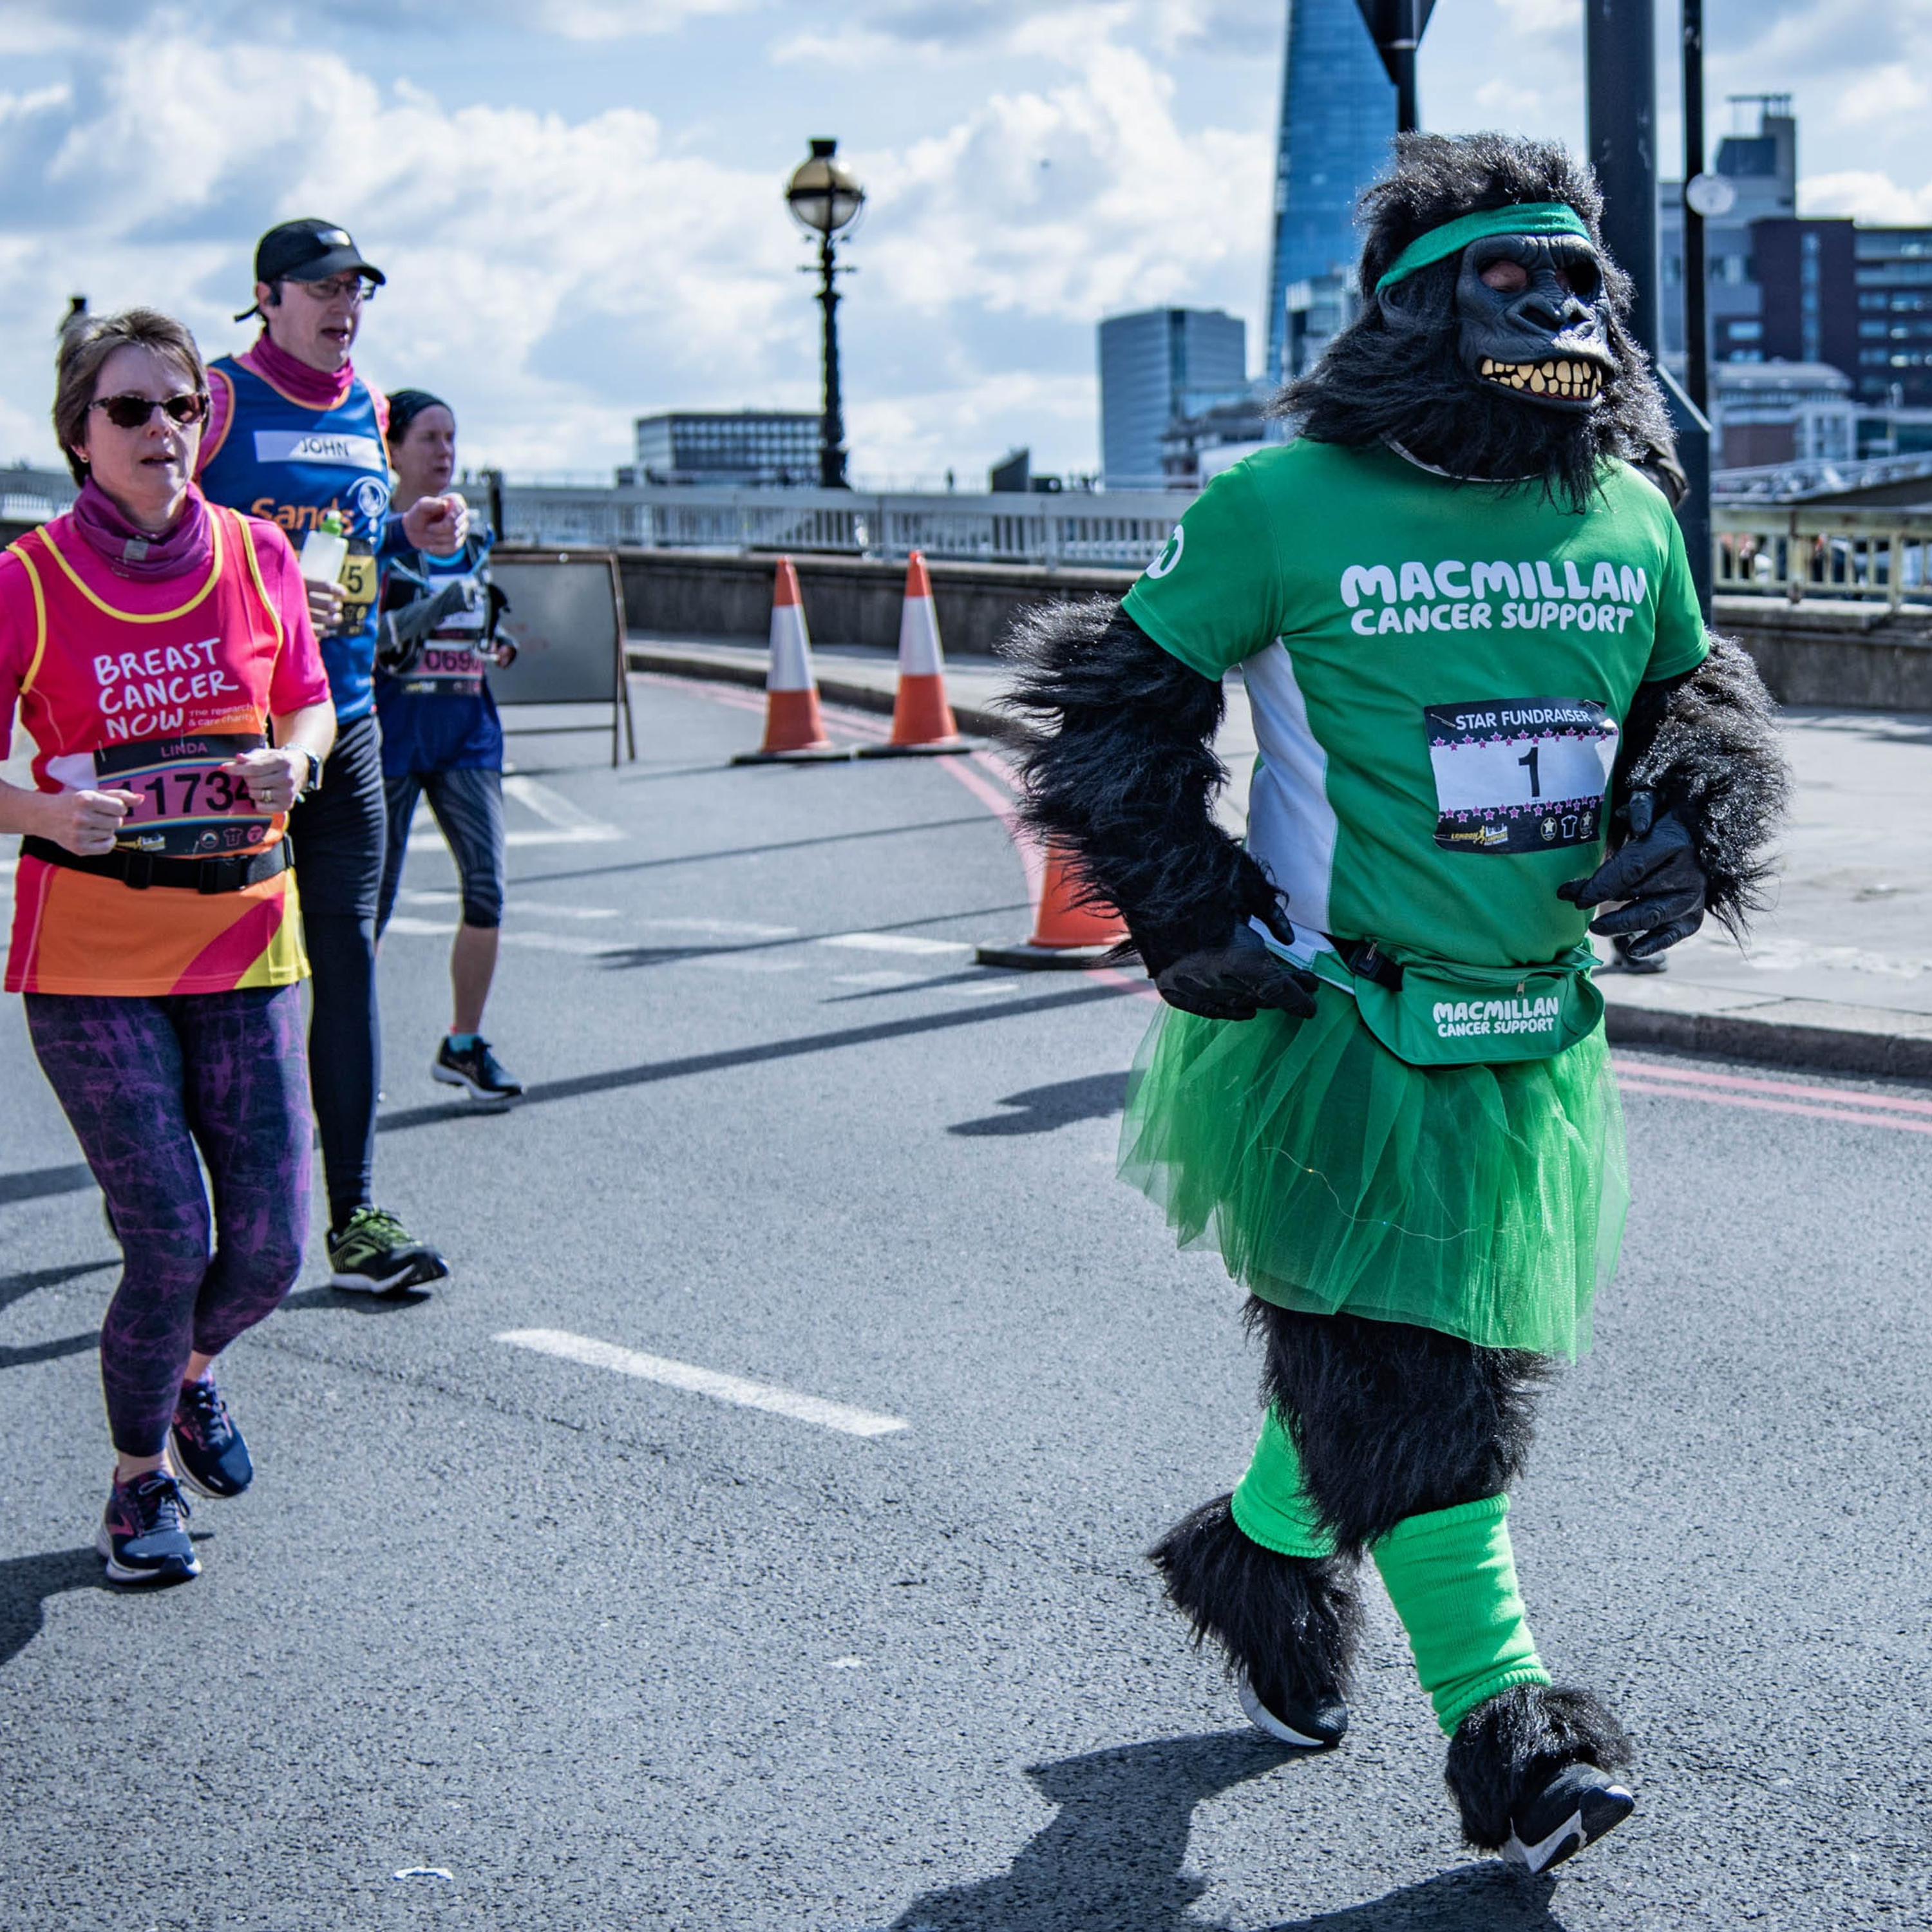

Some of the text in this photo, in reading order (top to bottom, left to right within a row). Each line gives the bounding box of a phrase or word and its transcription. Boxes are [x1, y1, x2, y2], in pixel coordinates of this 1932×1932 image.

[300, 438, 349, 457] JOHN
[1340, 560, 1646, 608] MACMILLAN
[1351, 601, 1634, 636] CANCER SUPPORT
[93, 637, 221, 687] BREAST
[99, 670, 239, 715] CANCER
[106, 707, 184, 740] NOW
[1455, 708, 1592, 730] STAR FUNDRAISER
[161, 743, 207, 757] LINDA
[1518, 746, 1540, 797] 1
[1433, 997, 1559, 1023] MACMILLAN
[1437, 1018, 1554, 1037] CANCER SUPPORT
